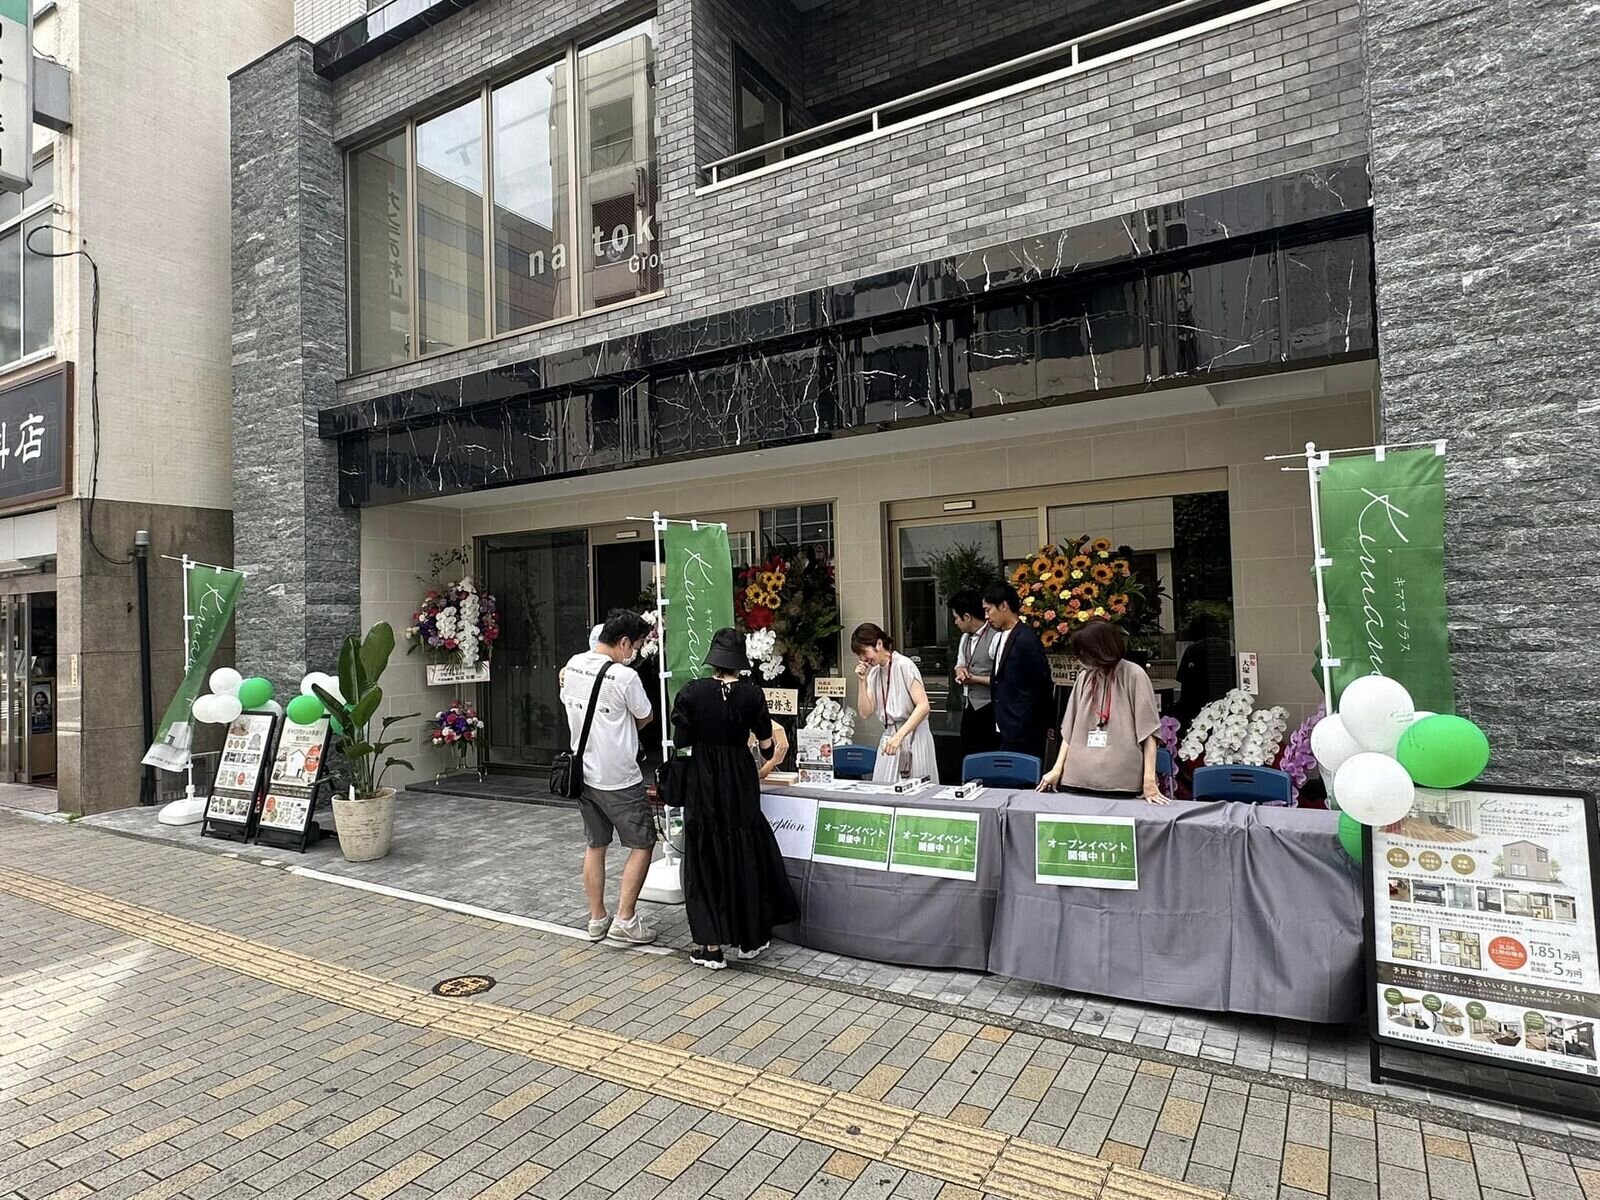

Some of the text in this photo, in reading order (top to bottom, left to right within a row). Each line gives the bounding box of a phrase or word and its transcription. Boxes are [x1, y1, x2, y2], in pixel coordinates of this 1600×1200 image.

[824, 822, 886, 838] オープンイベント
[837, 833, 875, 847] 開催中！！
[902, 830, 971, 846] オープンイベント
[917, 841, 960, 855] 開催中！！
[1047, 838, 1128, 853] オープンイベント
[1067, 850, 1116, 863] 開催中！！
